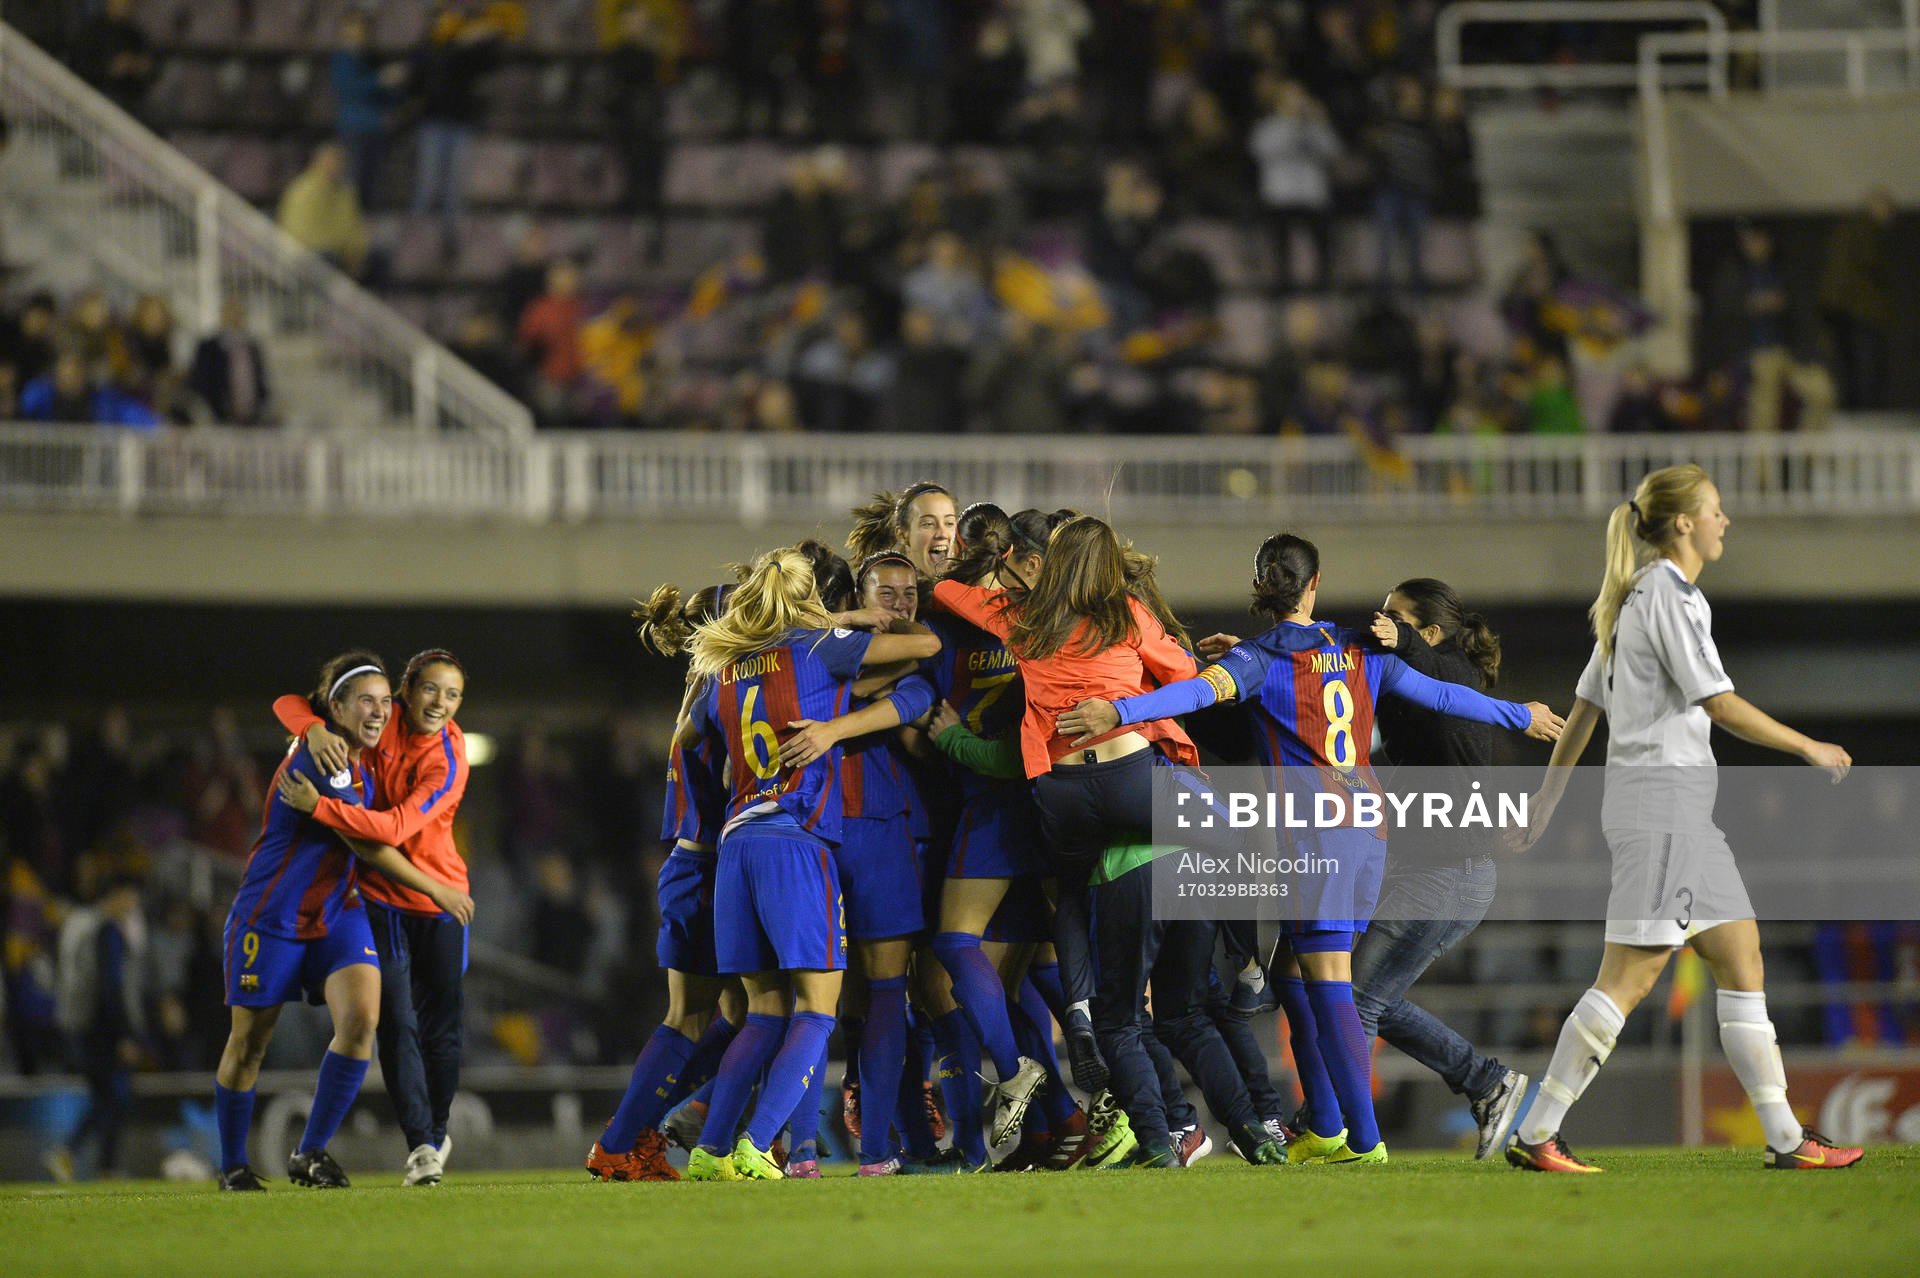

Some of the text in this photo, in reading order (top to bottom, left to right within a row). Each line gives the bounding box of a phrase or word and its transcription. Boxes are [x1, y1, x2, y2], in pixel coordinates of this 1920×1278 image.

[968, 649, 1019, 671] GEMM
[967, 672, 1017, 734] 7
[1323, 679, 1357, 774] 8
[740, 685, 781, 780] 6
[1675, 887, 1693, 931] 3
[243, 932, 260, 969] 9
